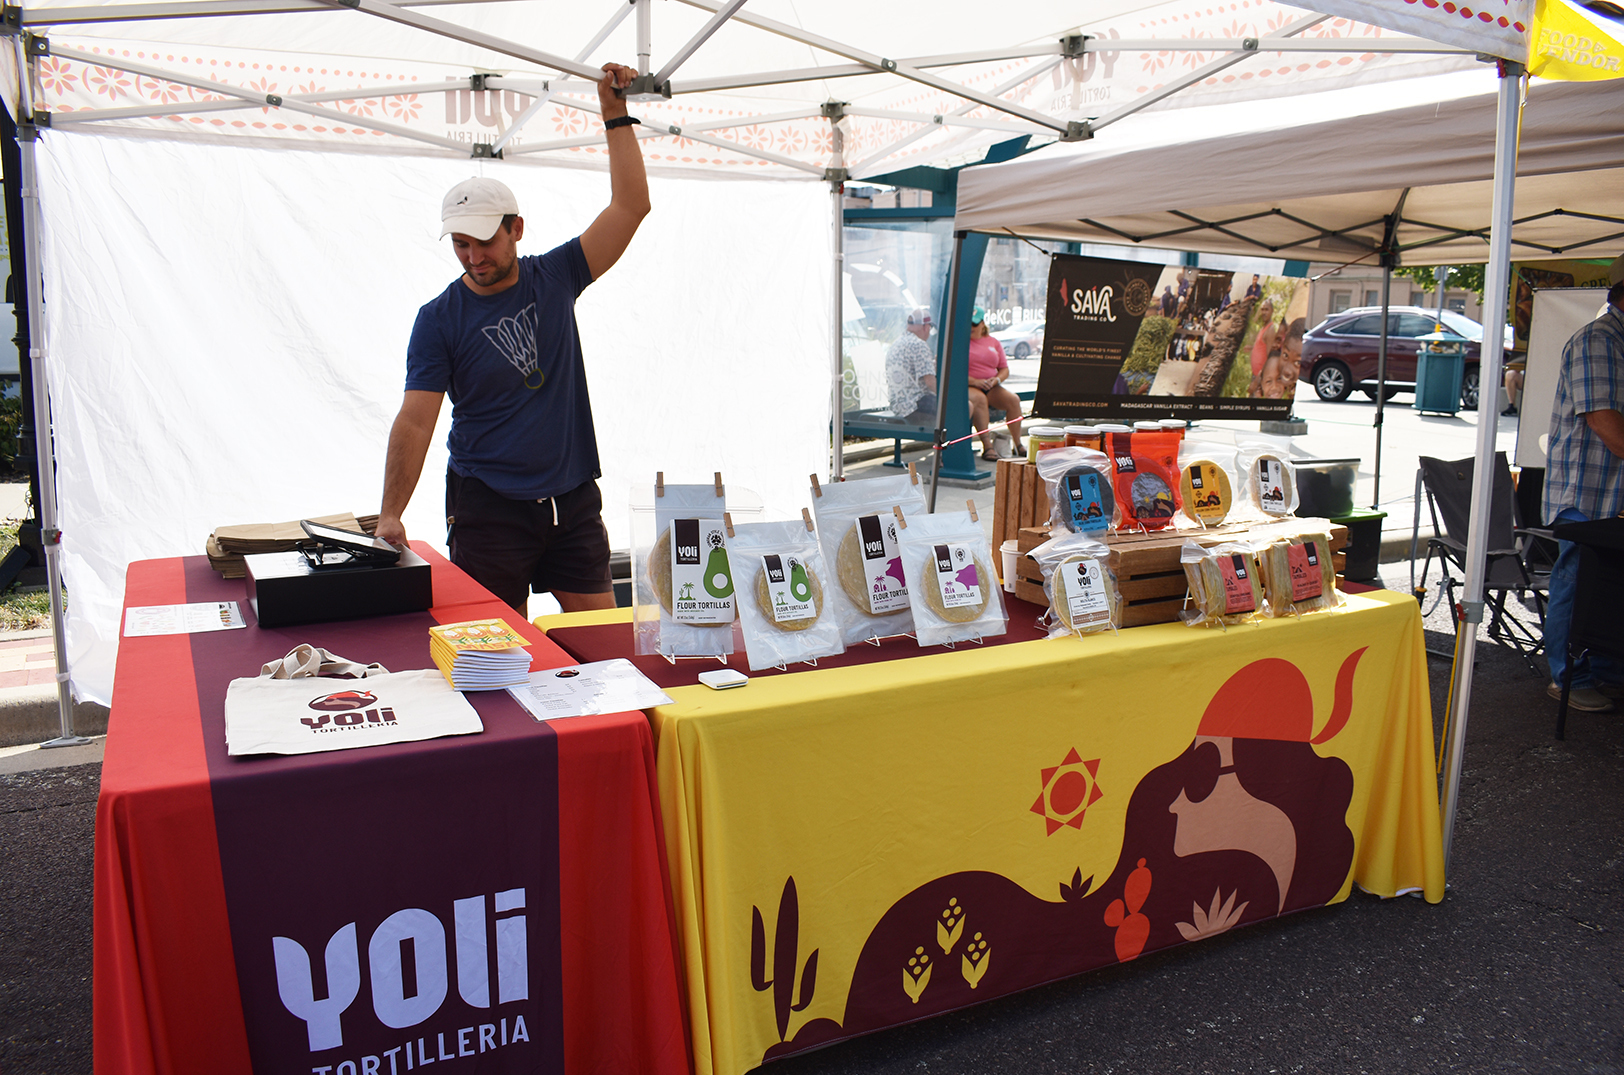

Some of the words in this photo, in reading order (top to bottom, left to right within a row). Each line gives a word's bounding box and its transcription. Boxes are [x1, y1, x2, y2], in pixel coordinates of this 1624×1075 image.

[1540, 28, 1592, 51] FOOD
[1537, 44, 1620, 72] VENDOR
[983, 308, 1011, 325] deKC
[1022, 308, 1045, 321] BUS
[1073, 314, 1098, 322] TRADING
[842, 368, 919, 388] OHNSON
[872, 592, 890, 601] FLOUR
[677, 602, 692, 610] FLOUR
[698, 601, 731, 609] TORTILLAS
[311, 721, 398, 734] TORTILLERIA
